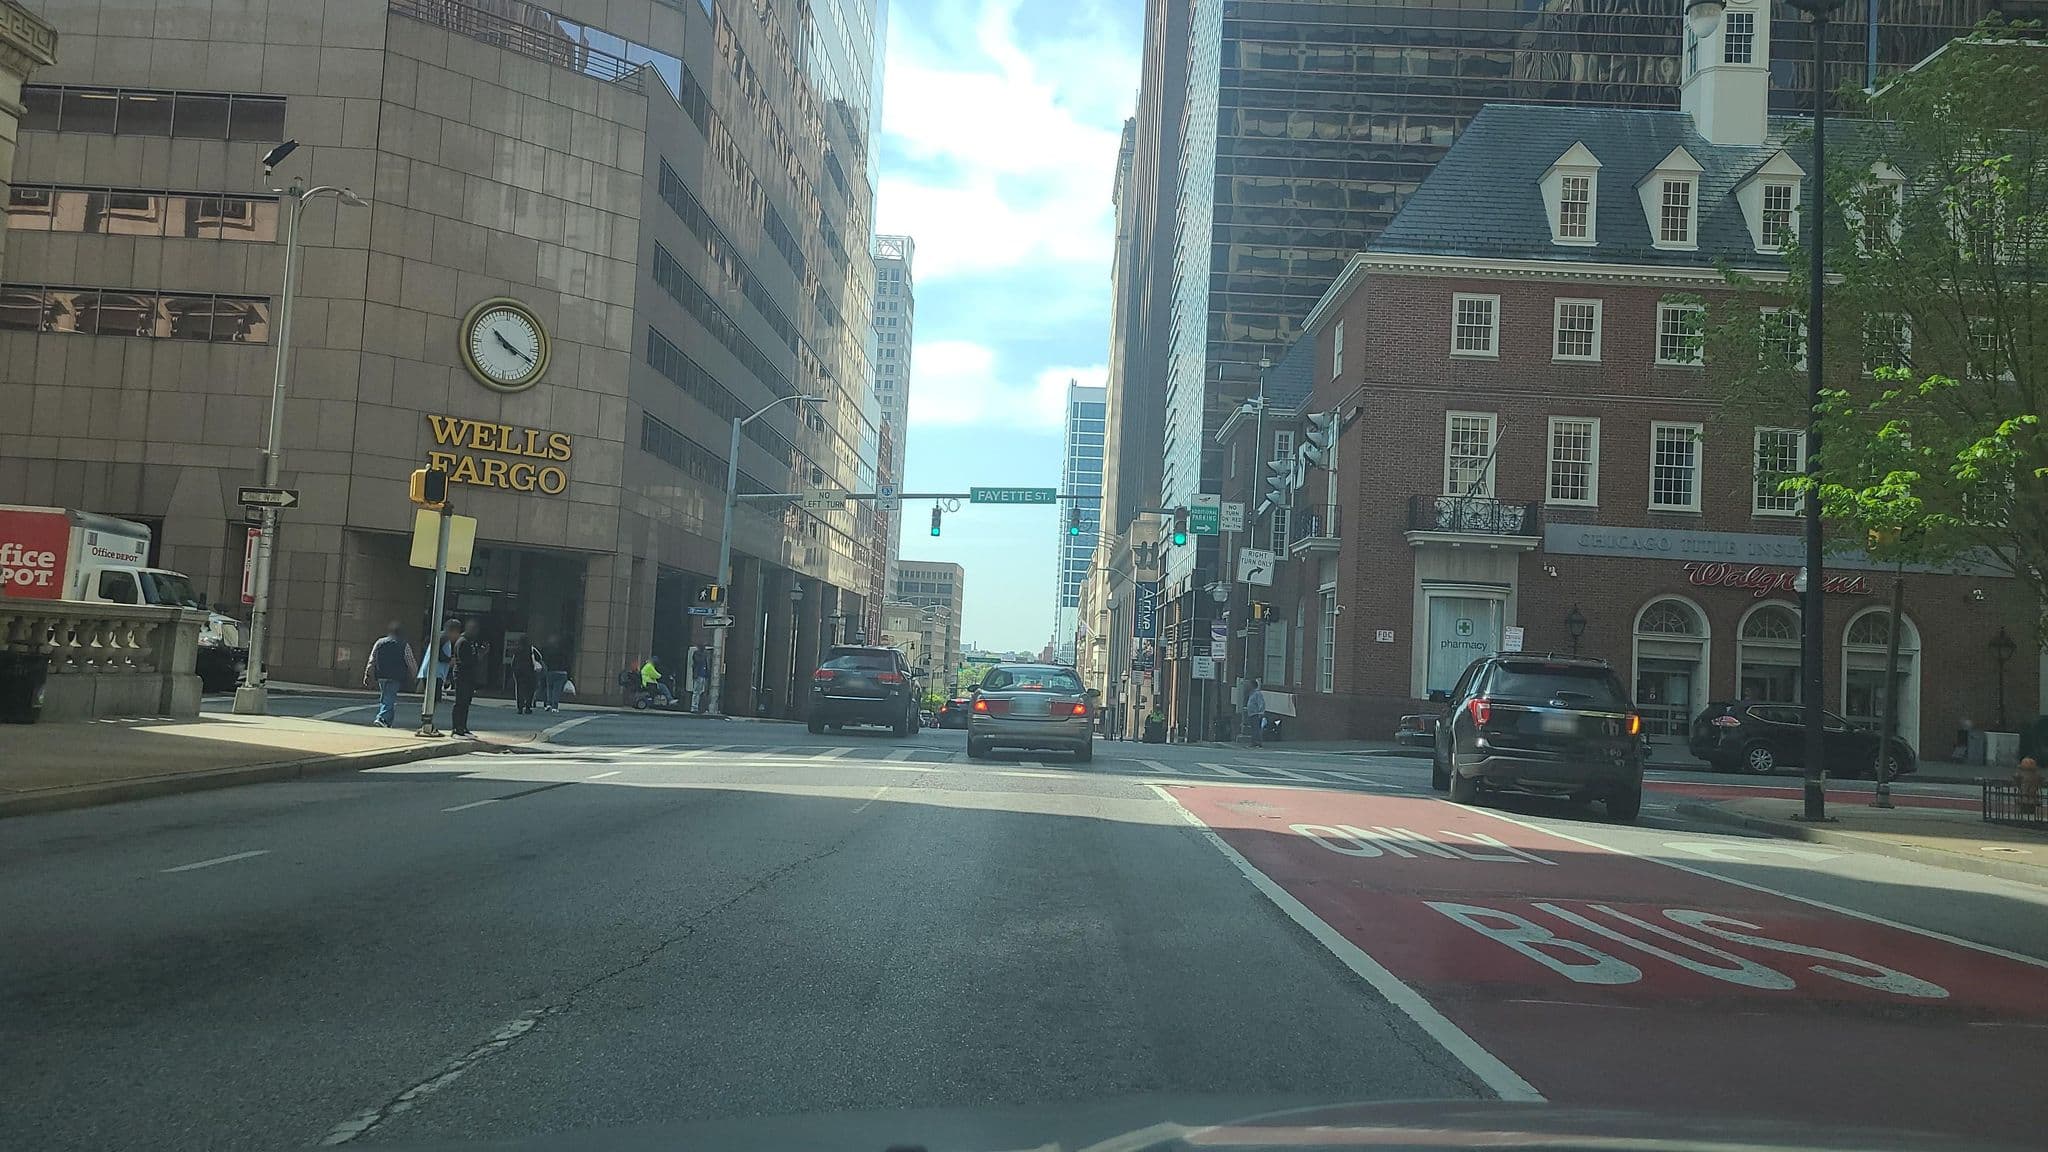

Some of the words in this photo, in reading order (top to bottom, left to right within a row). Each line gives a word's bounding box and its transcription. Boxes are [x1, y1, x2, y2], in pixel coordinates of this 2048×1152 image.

[427, 414, 572, 461] WELLS
[428, 451, 567, 495] FARGO
[804, 500, 821, 508] LEFT
[826, 501, 845, 509] TURN
[978, 490, 1033, 501] FAYETTE
[1034, 491, 1050, 501] ST.
[1192, 514, 1217, 522] PARKING
[1577, 533, 1672, 551] CHICAGO
[1681, 537, 1735, 556] TITLE
[92, 547, 115, 559] Office
[115, 553, 138, 562] DEPOT
[1241, 557, 1256, 565] TURN
[1257, 559, 1273, 567] ONLY
[1142, 588, 1155, 630] Arrive
[1440, 640, 1488, 652] pharmacy
[1288, 824, 1559, 866] ONLY
[1423, 901, 1950, 999] BUS
